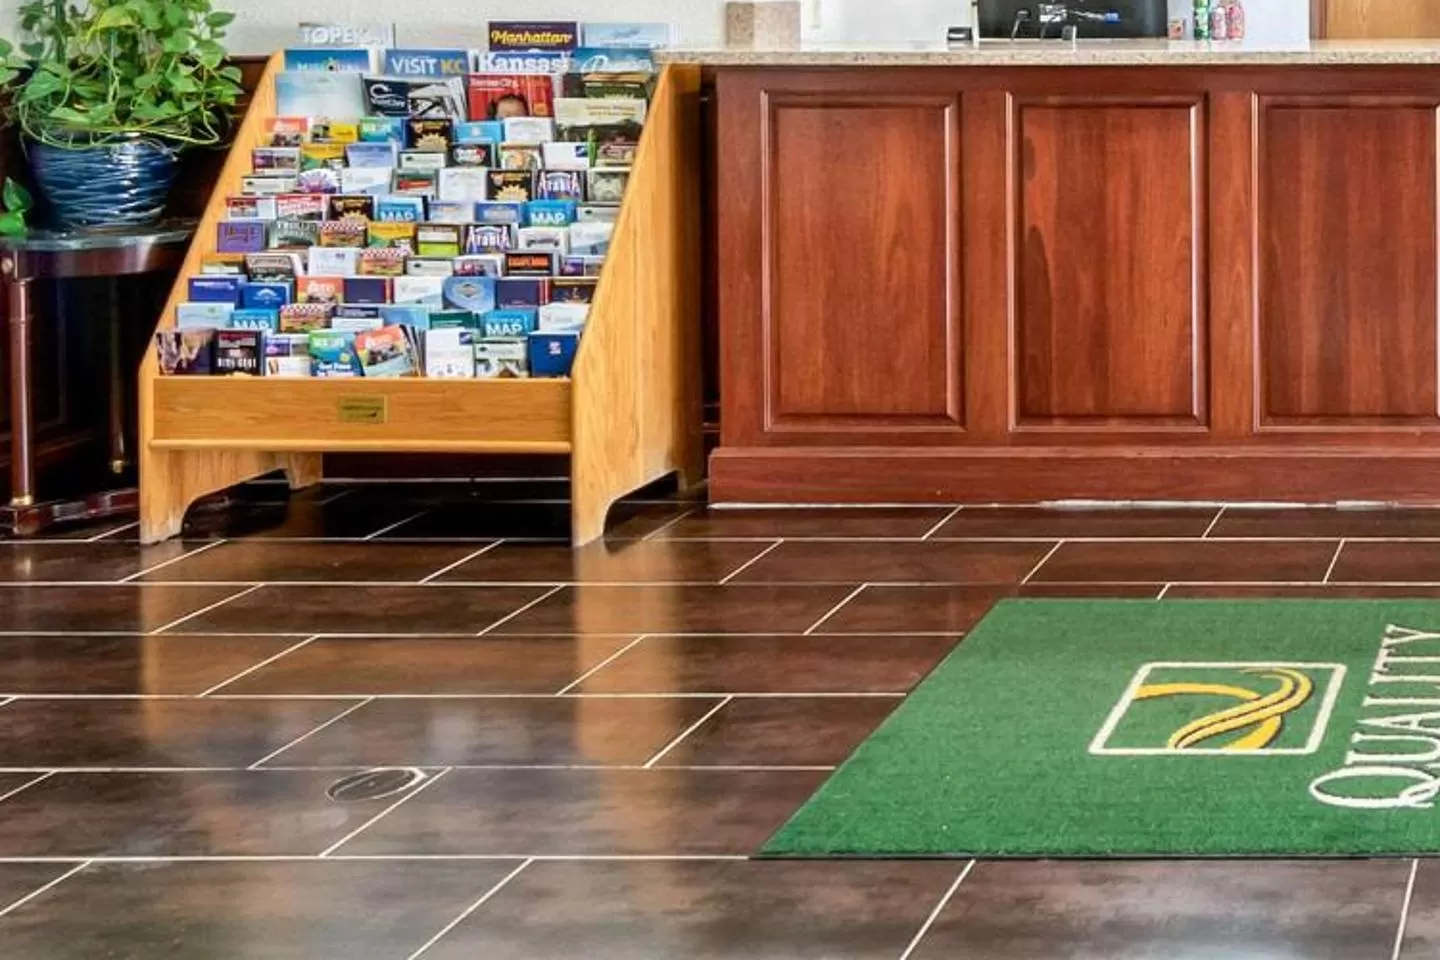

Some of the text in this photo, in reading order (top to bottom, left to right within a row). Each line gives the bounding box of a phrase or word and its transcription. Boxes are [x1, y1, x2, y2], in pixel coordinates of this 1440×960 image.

[491, 28, 573, 45] Manhattan
[391, 55, 465, 74] VISIT KC
[530, 212, 566, 226] MAP
[232, 318, 271, 330] MAP
[486, 324, 524, 338] MAP
